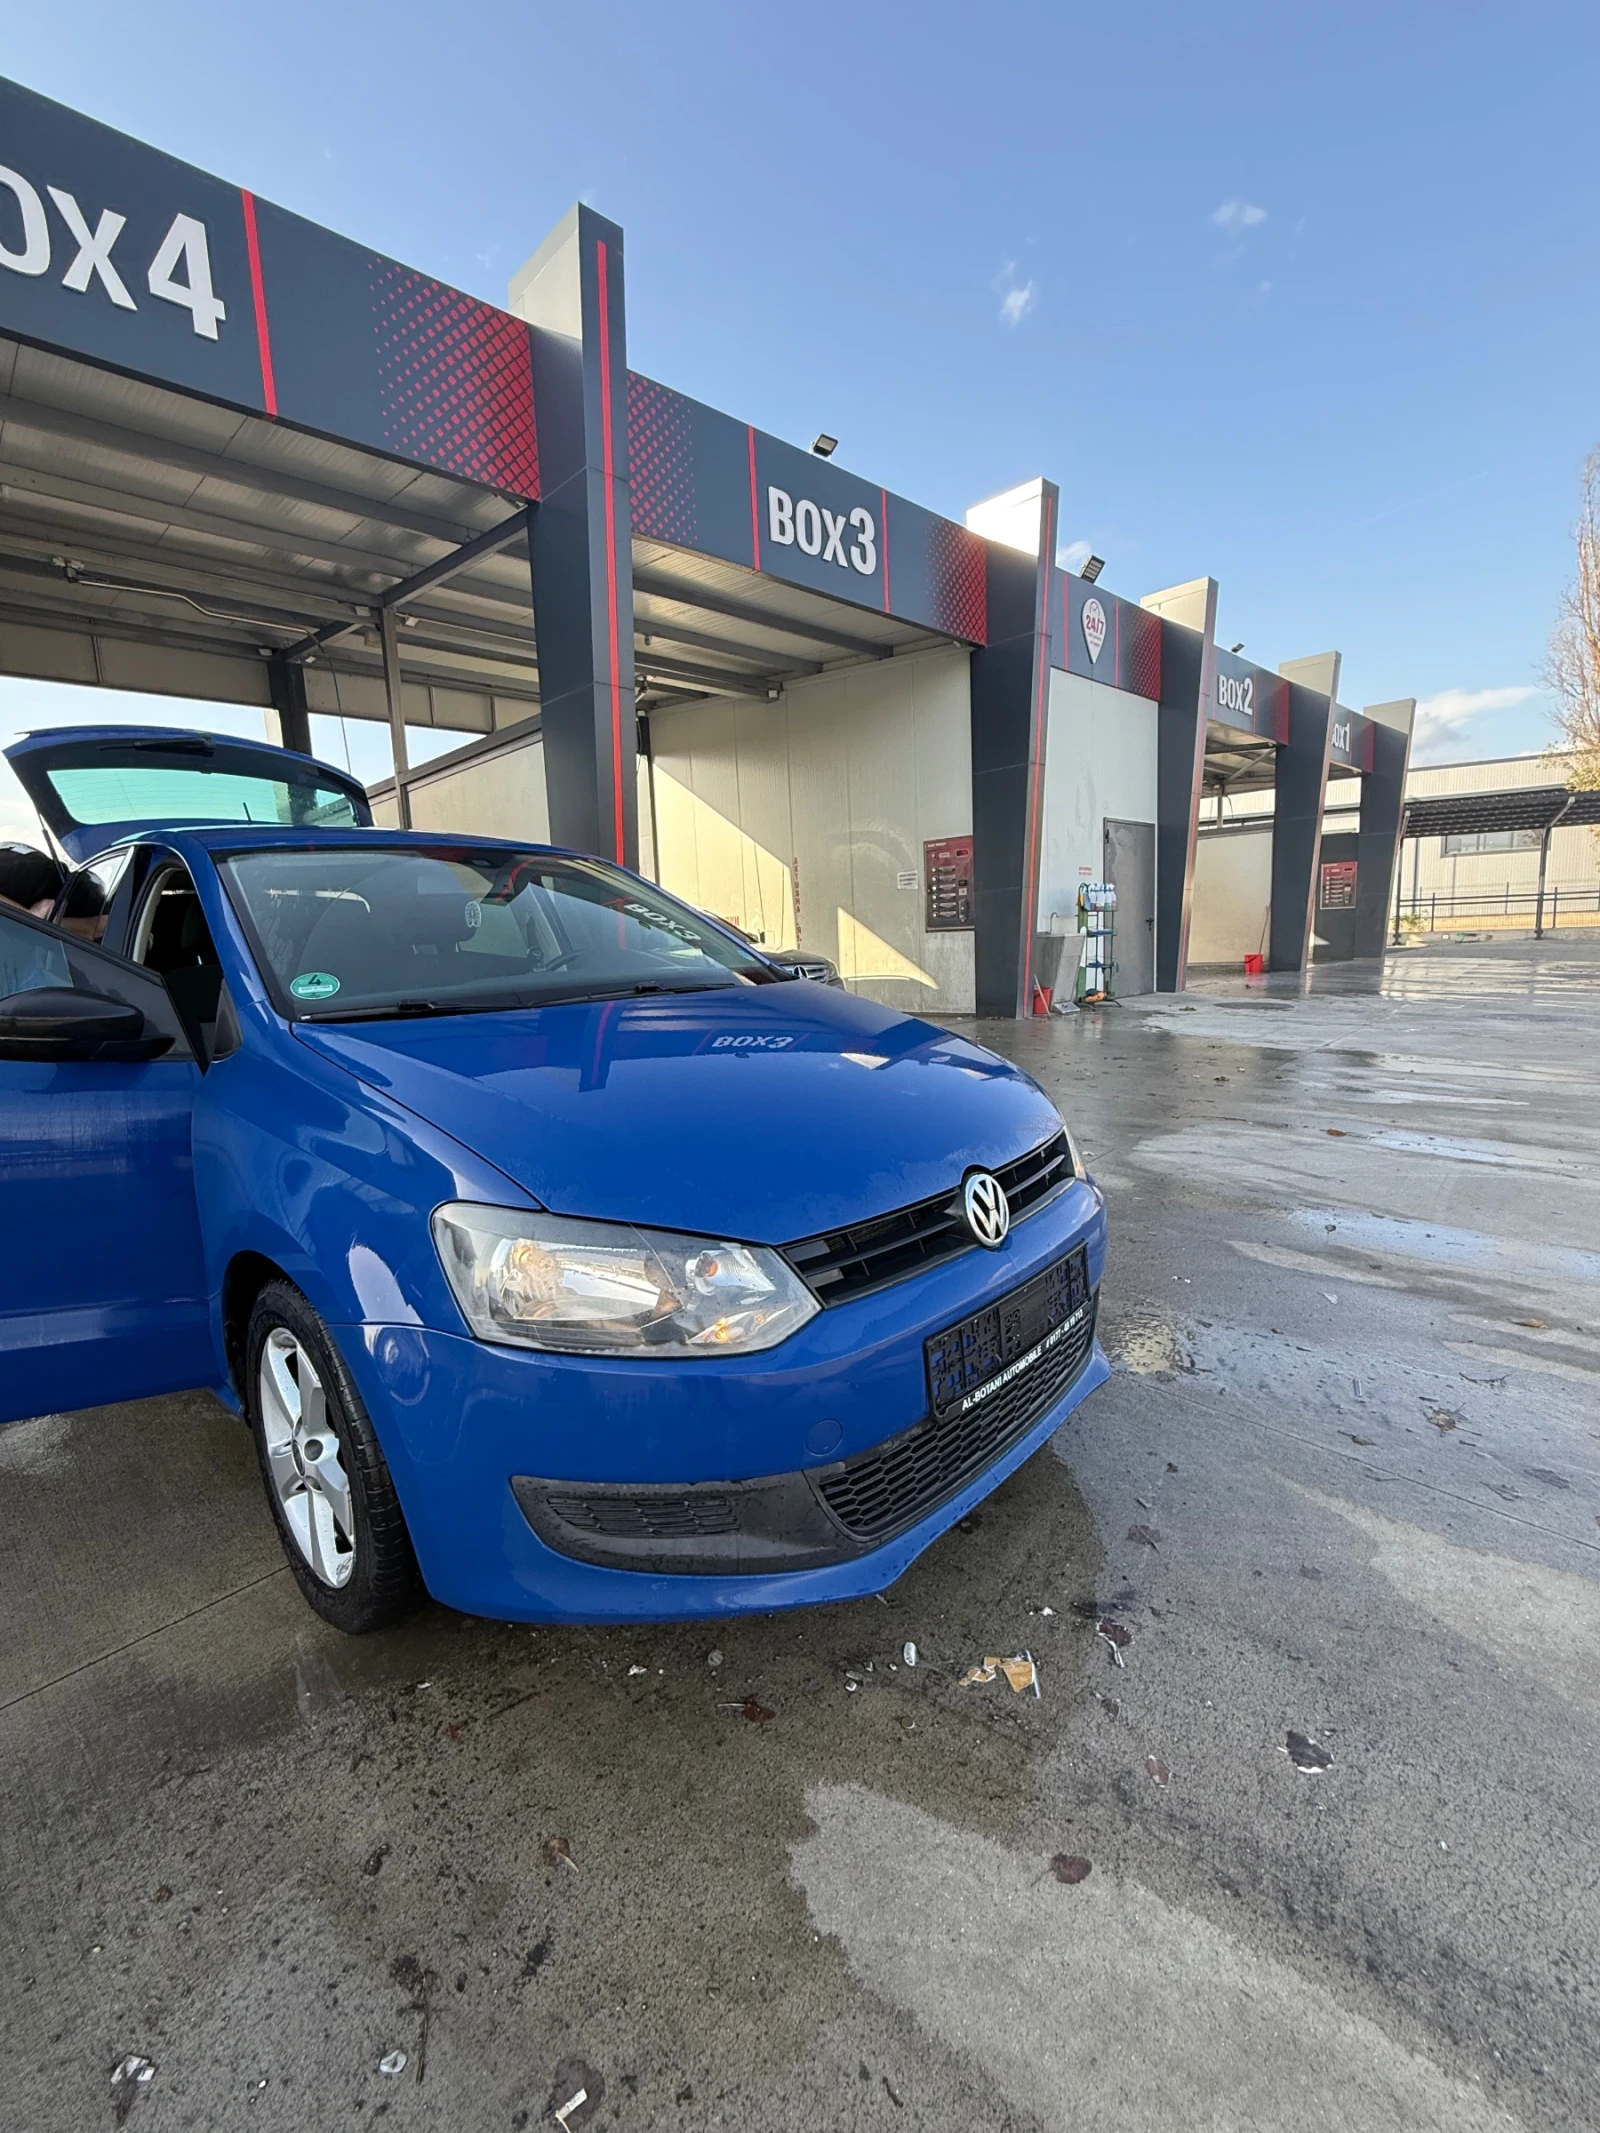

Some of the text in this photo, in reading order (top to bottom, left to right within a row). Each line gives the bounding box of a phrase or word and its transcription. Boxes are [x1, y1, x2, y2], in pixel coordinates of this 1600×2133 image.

[1086, 614, 1104, 635] 24/7
[308, 974, 322, 985] 4
[961, 1376, 1003, 1411] AL-BOTANI
[1002, 1345, 1042, 1384] AUTOMOBILE
